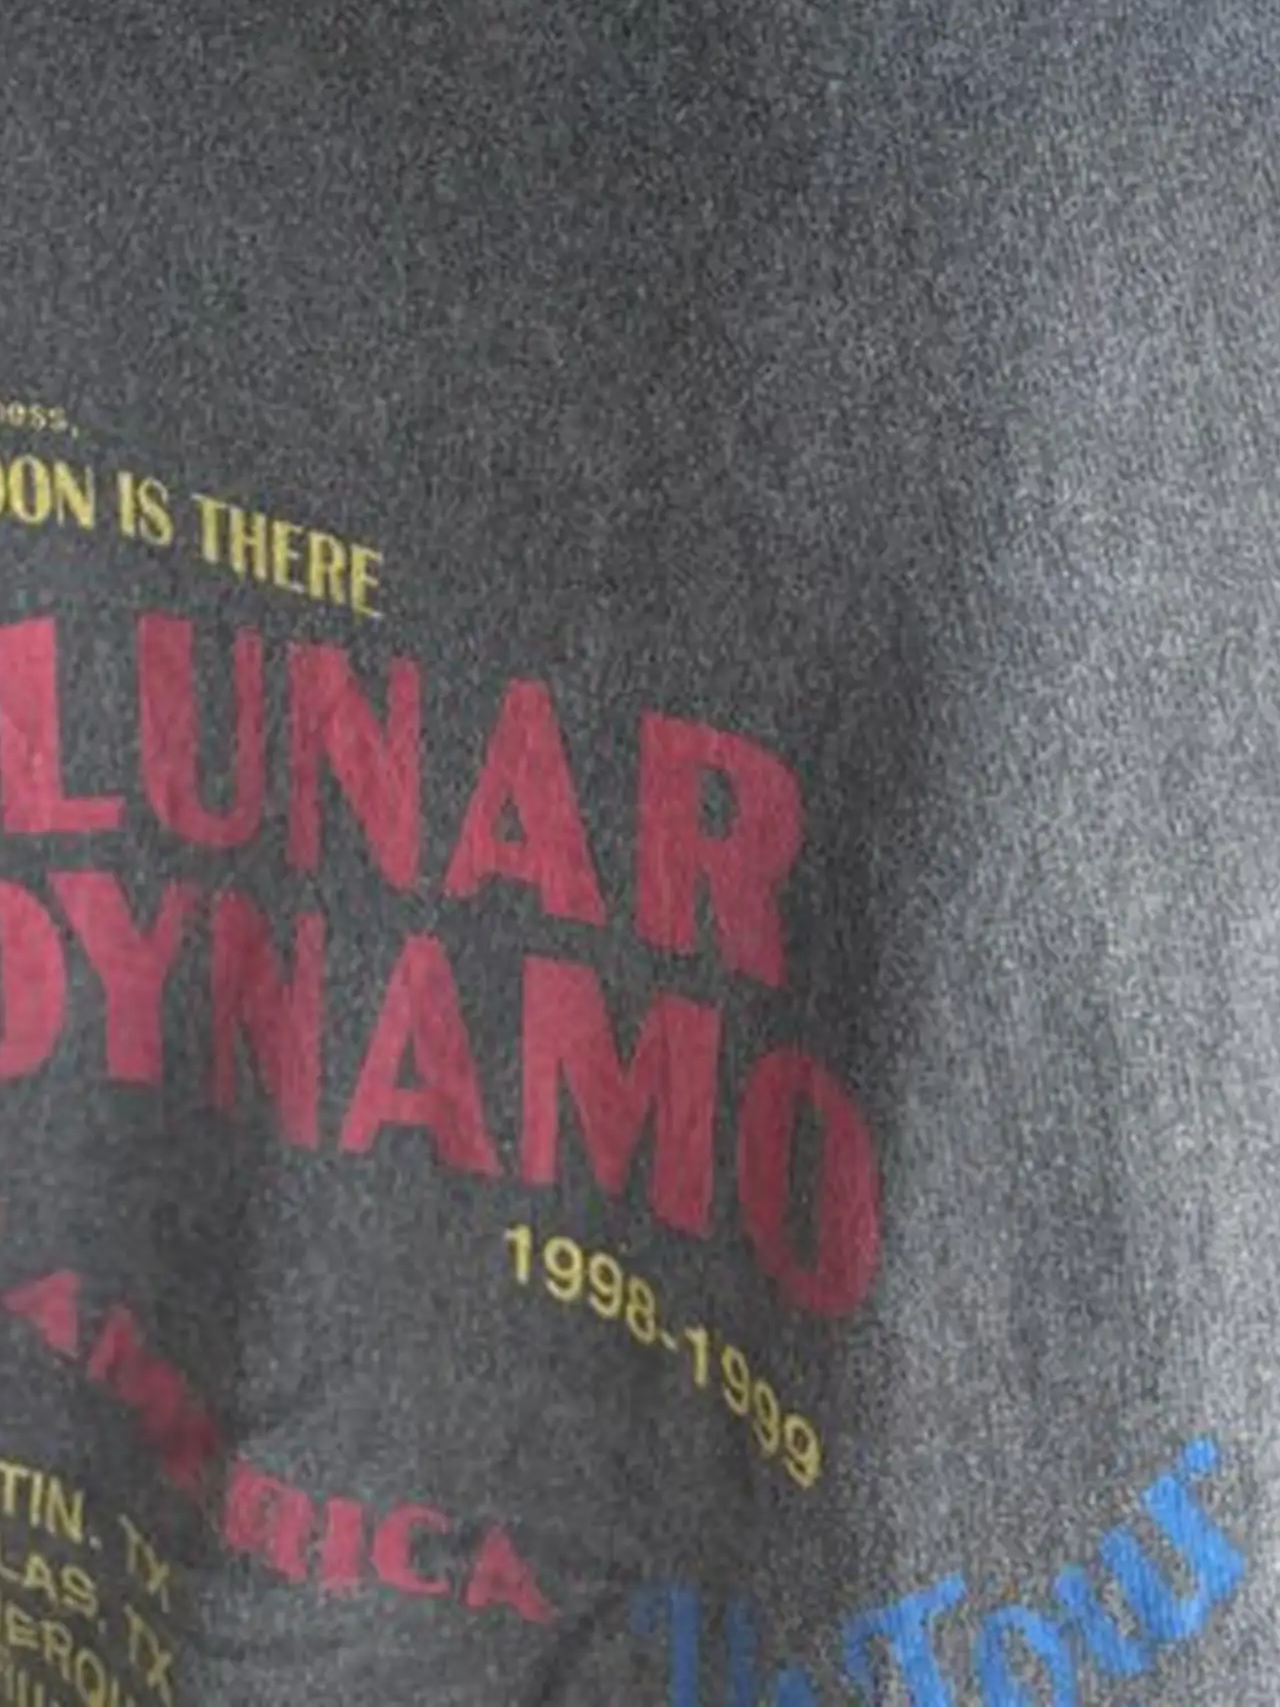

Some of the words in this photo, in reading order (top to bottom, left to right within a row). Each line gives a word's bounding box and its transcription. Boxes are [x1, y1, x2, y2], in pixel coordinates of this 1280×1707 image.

[119, 470, 175, 547] IS
[191, 492, 386, 619] THERE
[504, 1223, 823, 1489] 1998-1999
